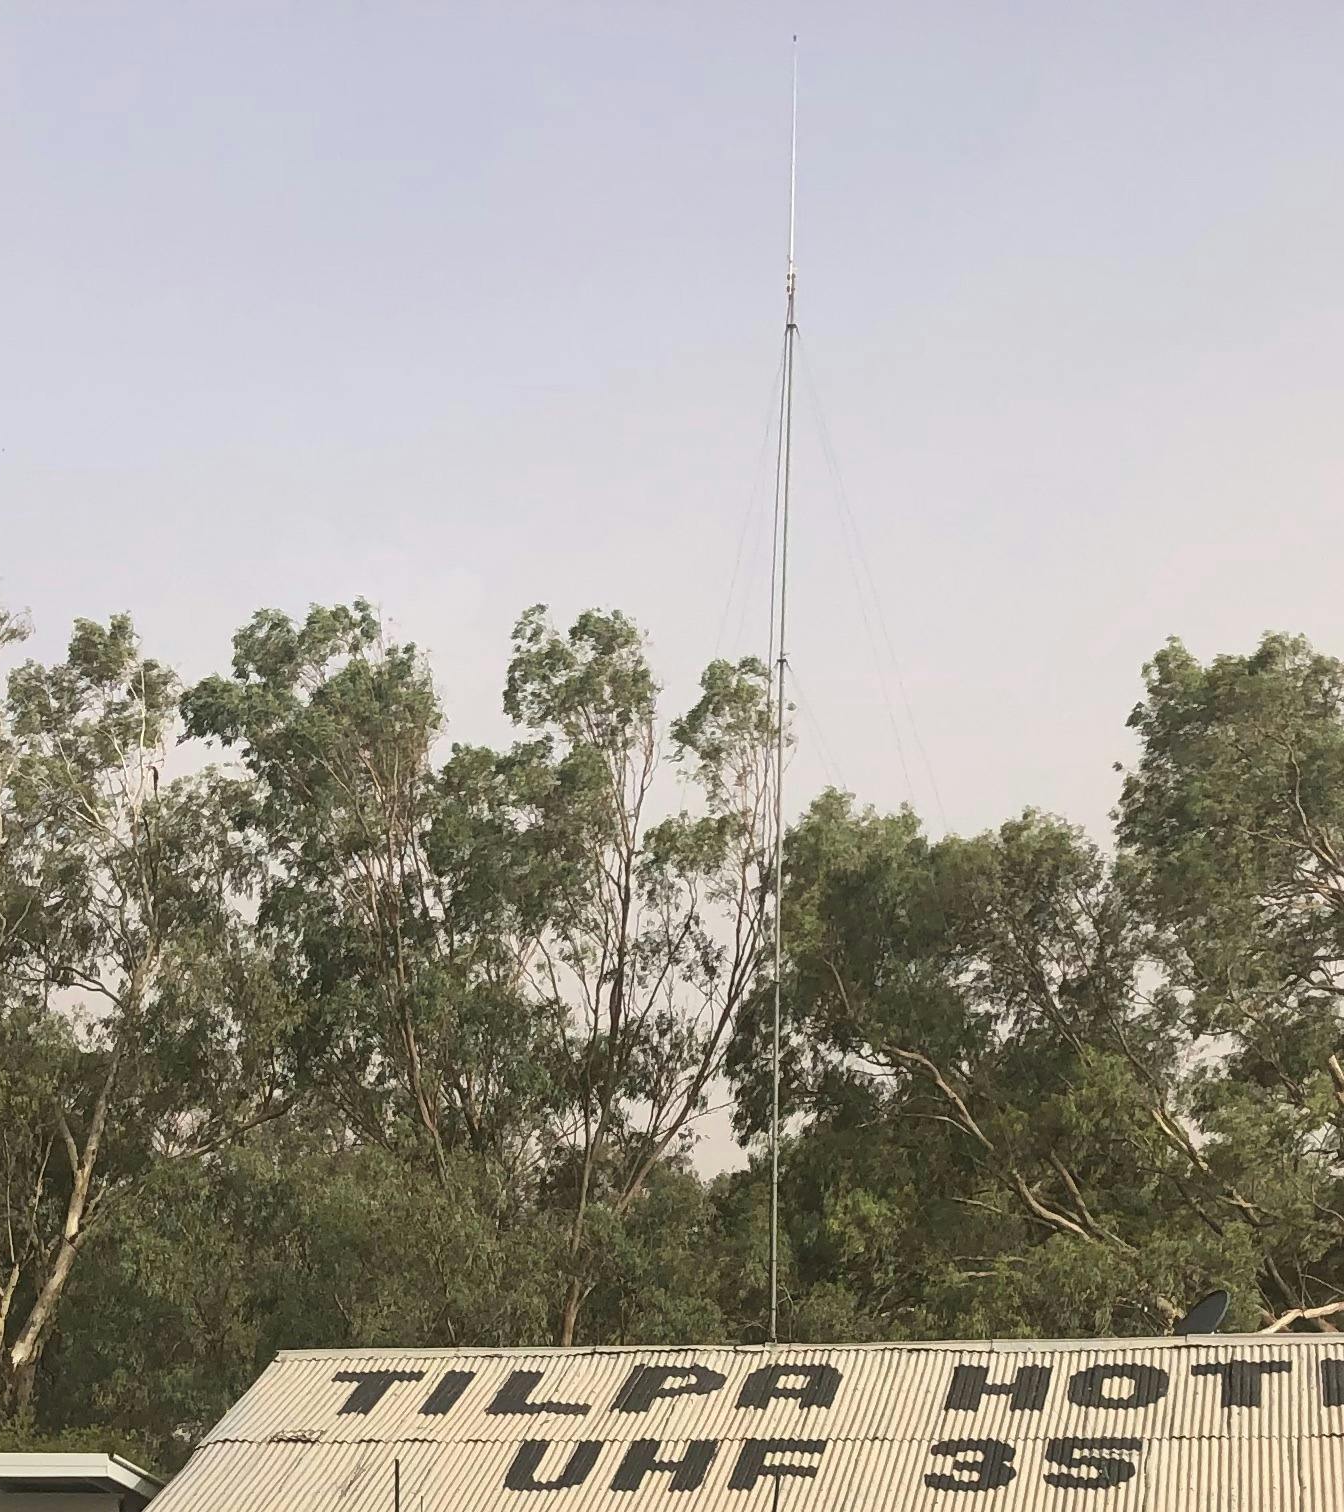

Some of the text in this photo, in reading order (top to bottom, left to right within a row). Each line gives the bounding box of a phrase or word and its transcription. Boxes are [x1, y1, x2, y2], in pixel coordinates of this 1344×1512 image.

[332, 1364, 843, 1416] TILPA
[504, 1437, 1142, 1491] UHF 35
